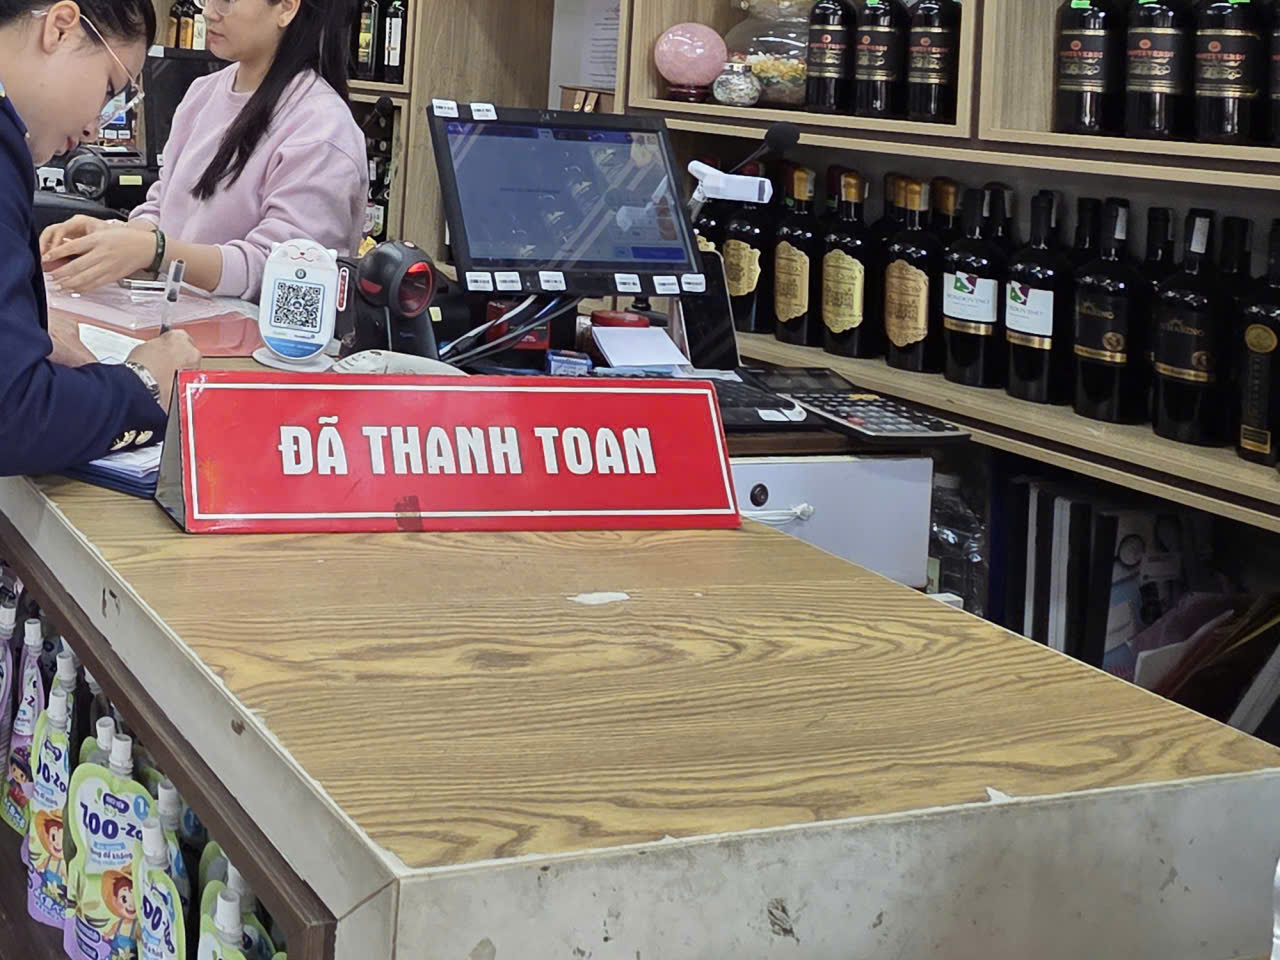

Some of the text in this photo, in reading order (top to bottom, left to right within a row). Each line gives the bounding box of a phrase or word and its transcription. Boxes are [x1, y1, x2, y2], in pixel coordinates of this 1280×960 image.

[278, 415, 657, 475] ĐÃ THANH TOAN
